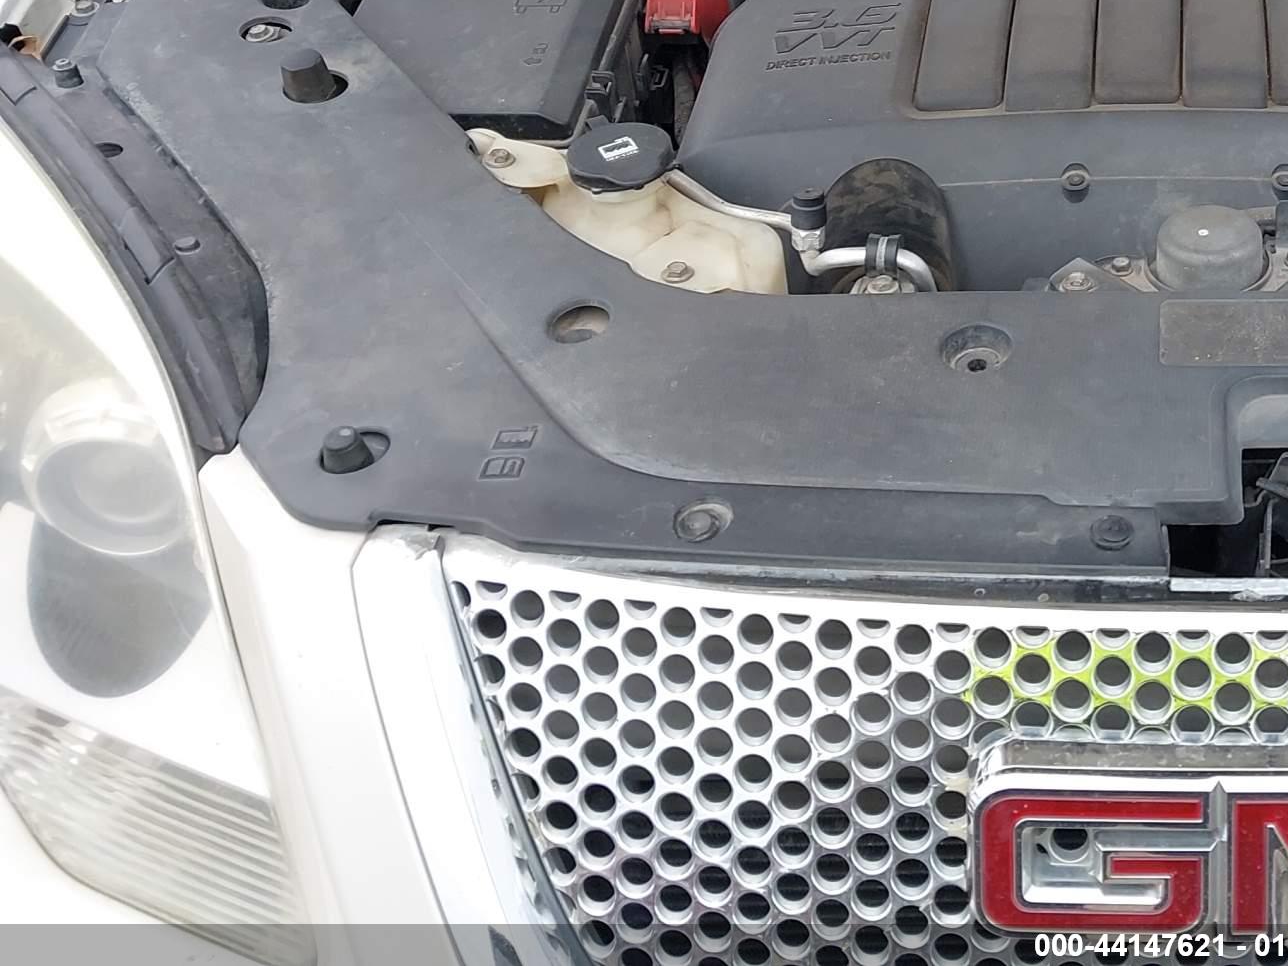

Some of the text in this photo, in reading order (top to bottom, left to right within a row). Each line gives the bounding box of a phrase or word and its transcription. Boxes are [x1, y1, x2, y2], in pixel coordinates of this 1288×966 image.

[776, 3, 902, 33] 3.6
[774, 27, 896, 54] VVT
[765, 51, 892, 71] DIRECT INJECTION
